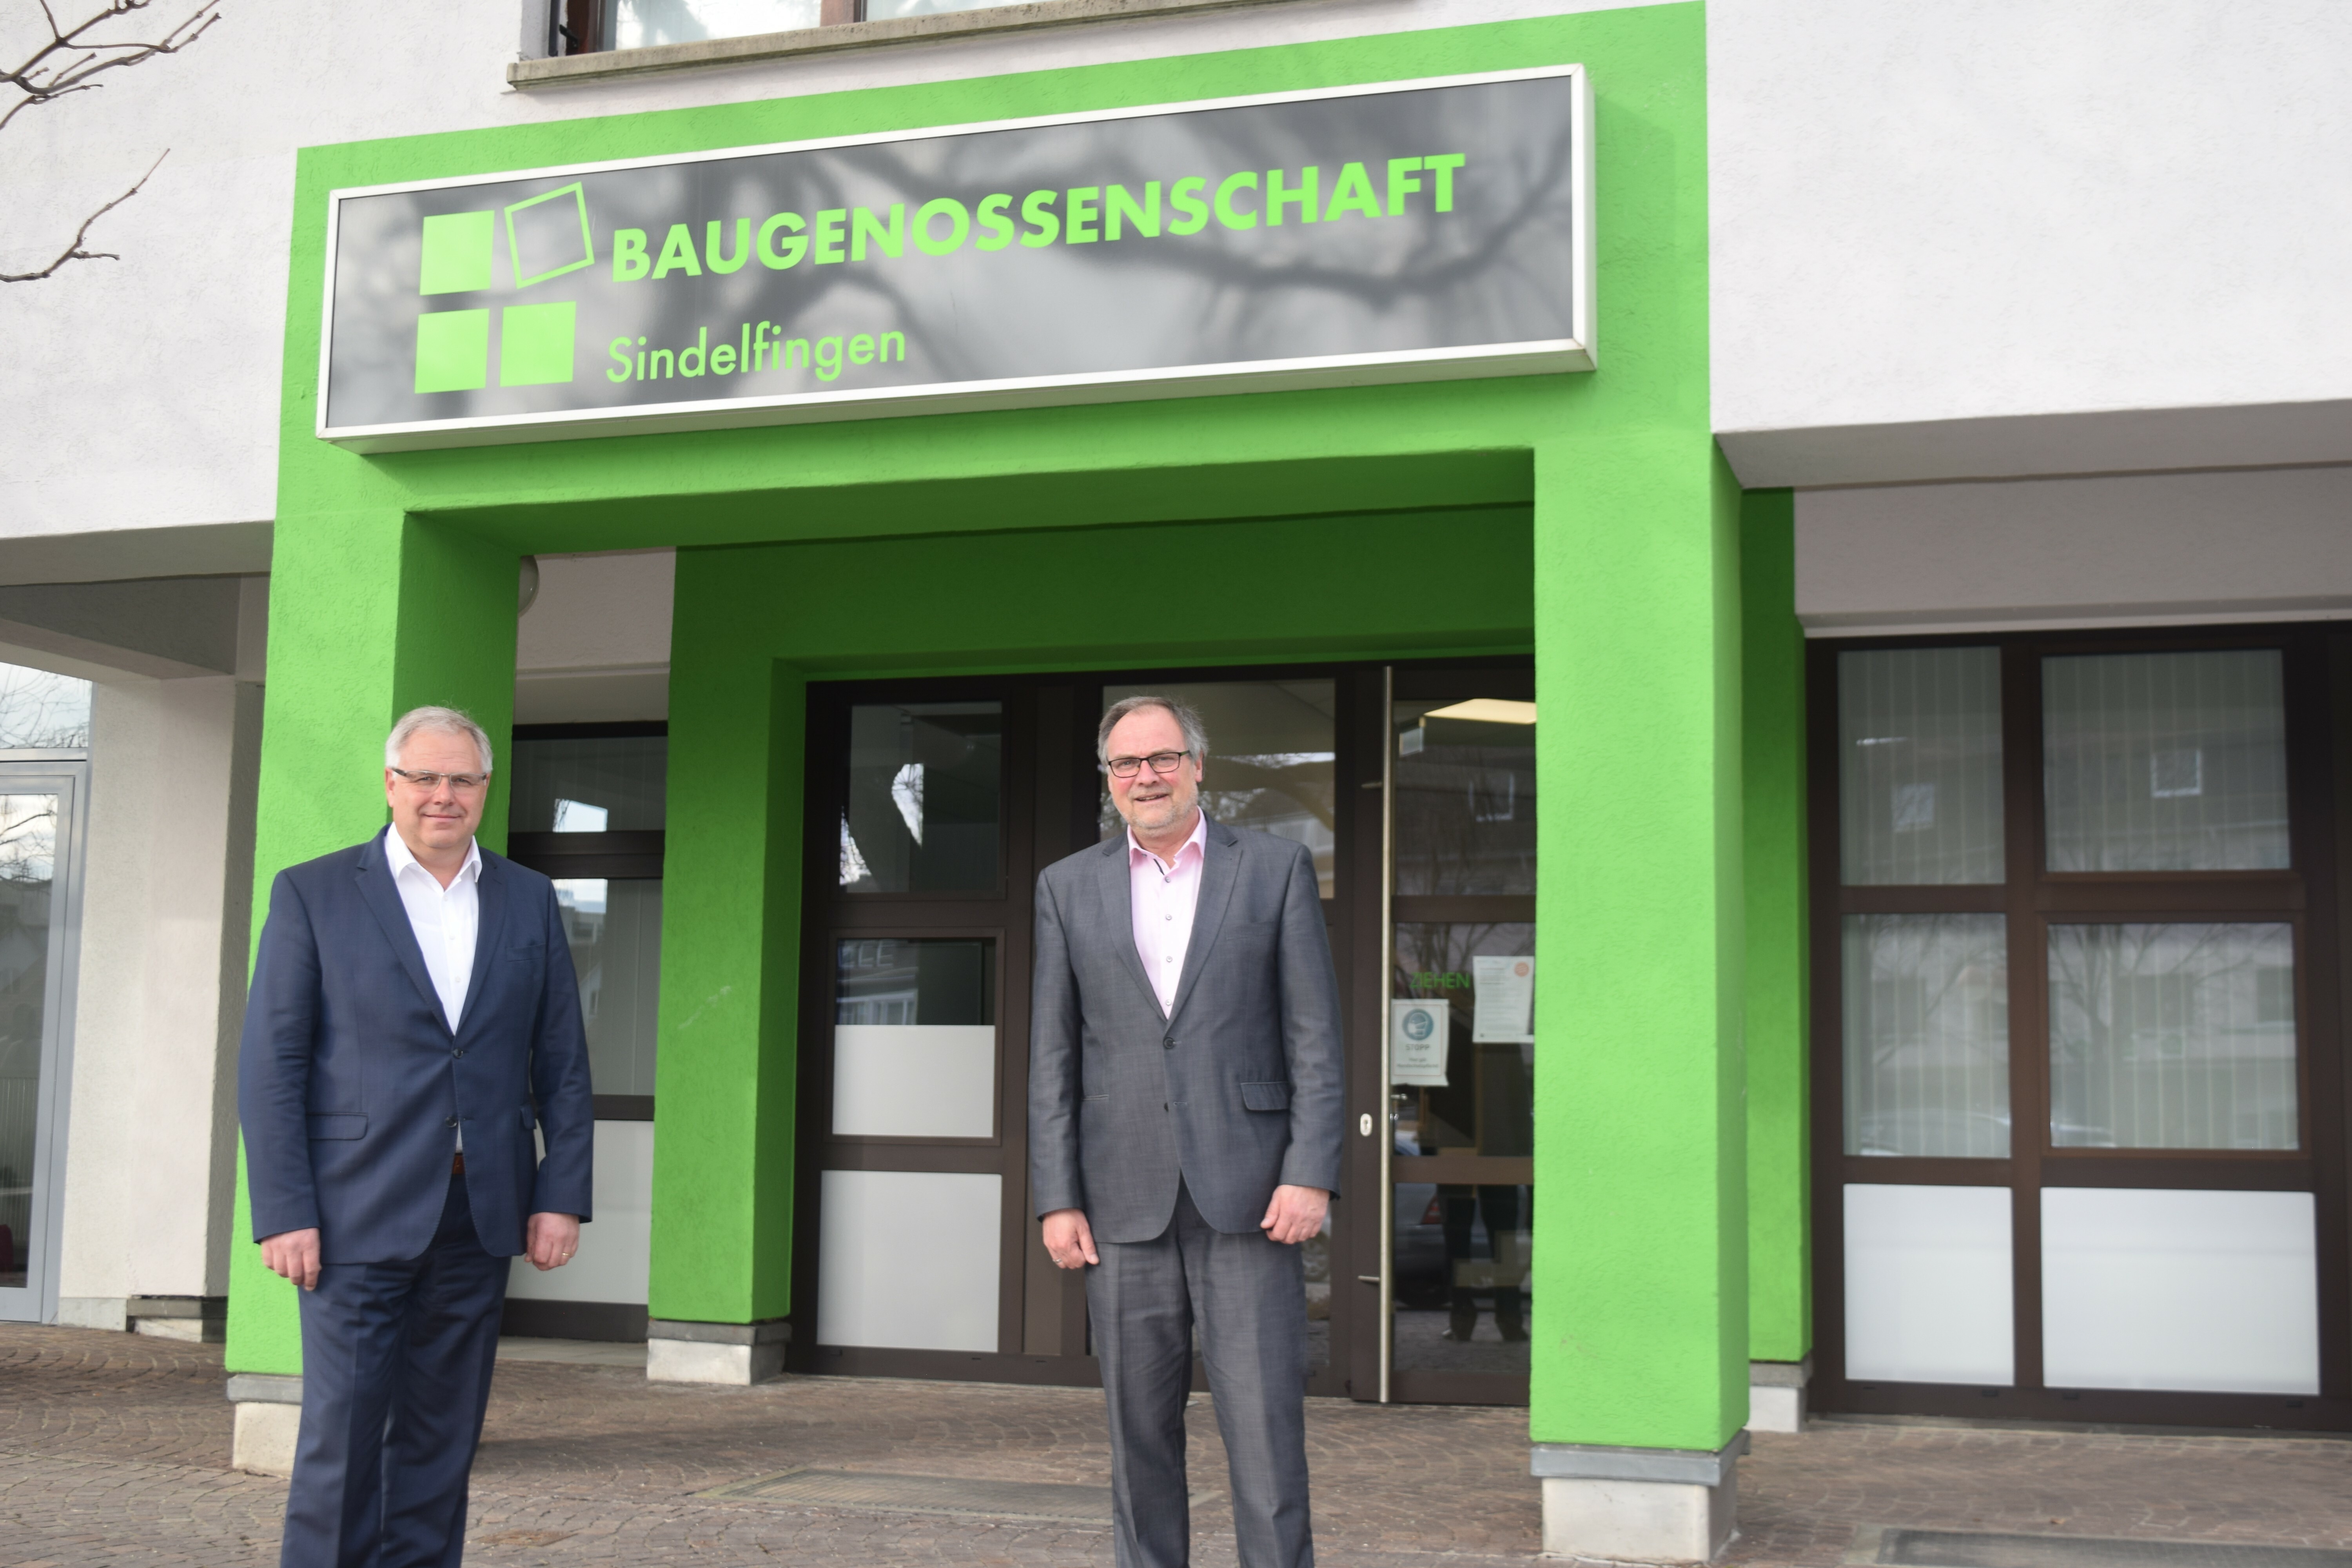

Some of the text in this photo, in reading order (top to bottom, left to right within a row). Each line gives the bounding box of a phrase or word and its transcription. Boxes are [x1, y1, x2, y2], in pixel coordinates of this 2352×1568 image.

[613, 153, 1465, 281] BAUGENOSSENSCHAFT
[606, 320, 905, 383] Sindelfingen
[1410, 972, 1470, 989] ZIEHEN
